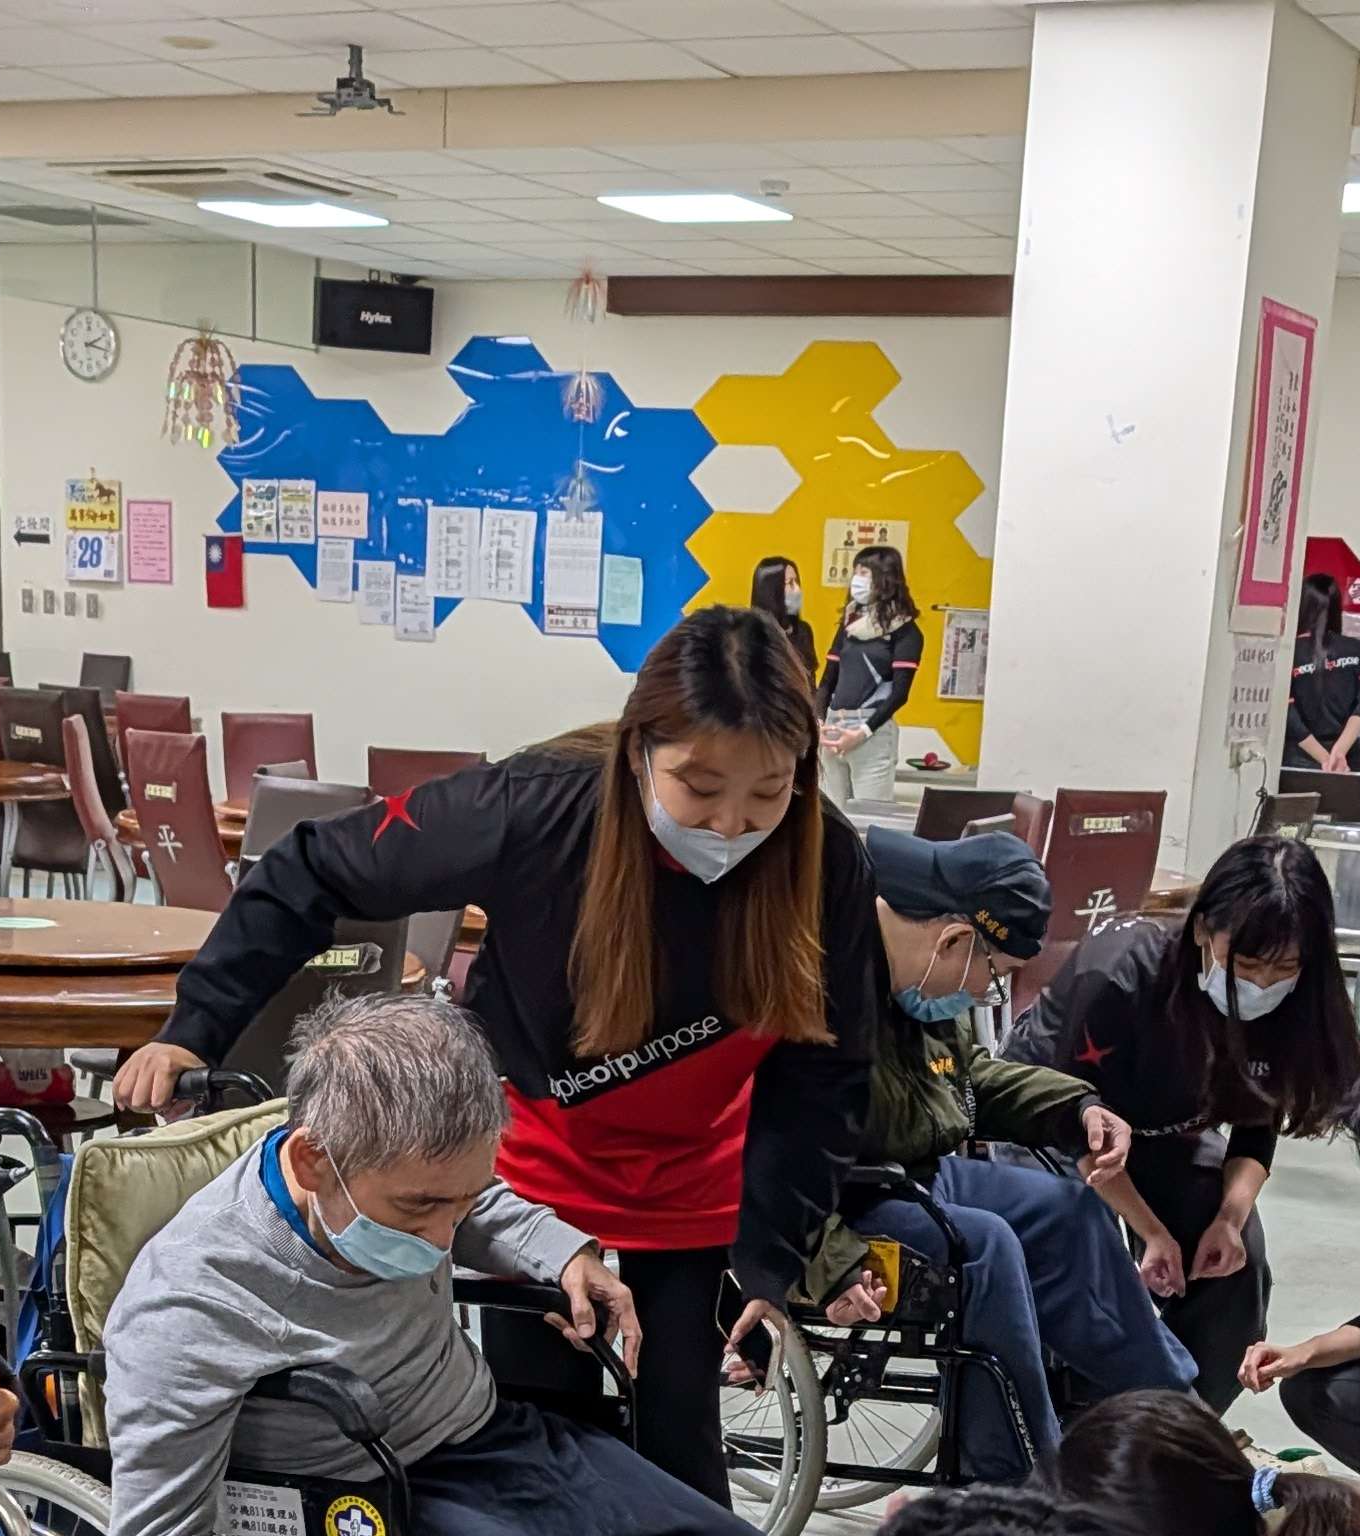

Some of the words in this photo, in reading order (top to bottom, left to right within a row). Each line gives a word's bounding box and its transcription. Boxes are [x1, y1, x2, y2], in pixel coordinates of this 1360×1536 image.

[78, 536, 103, 568] 28
[158, 824, 183, 863] 平
[1074, 887, 1118, 930] 平
